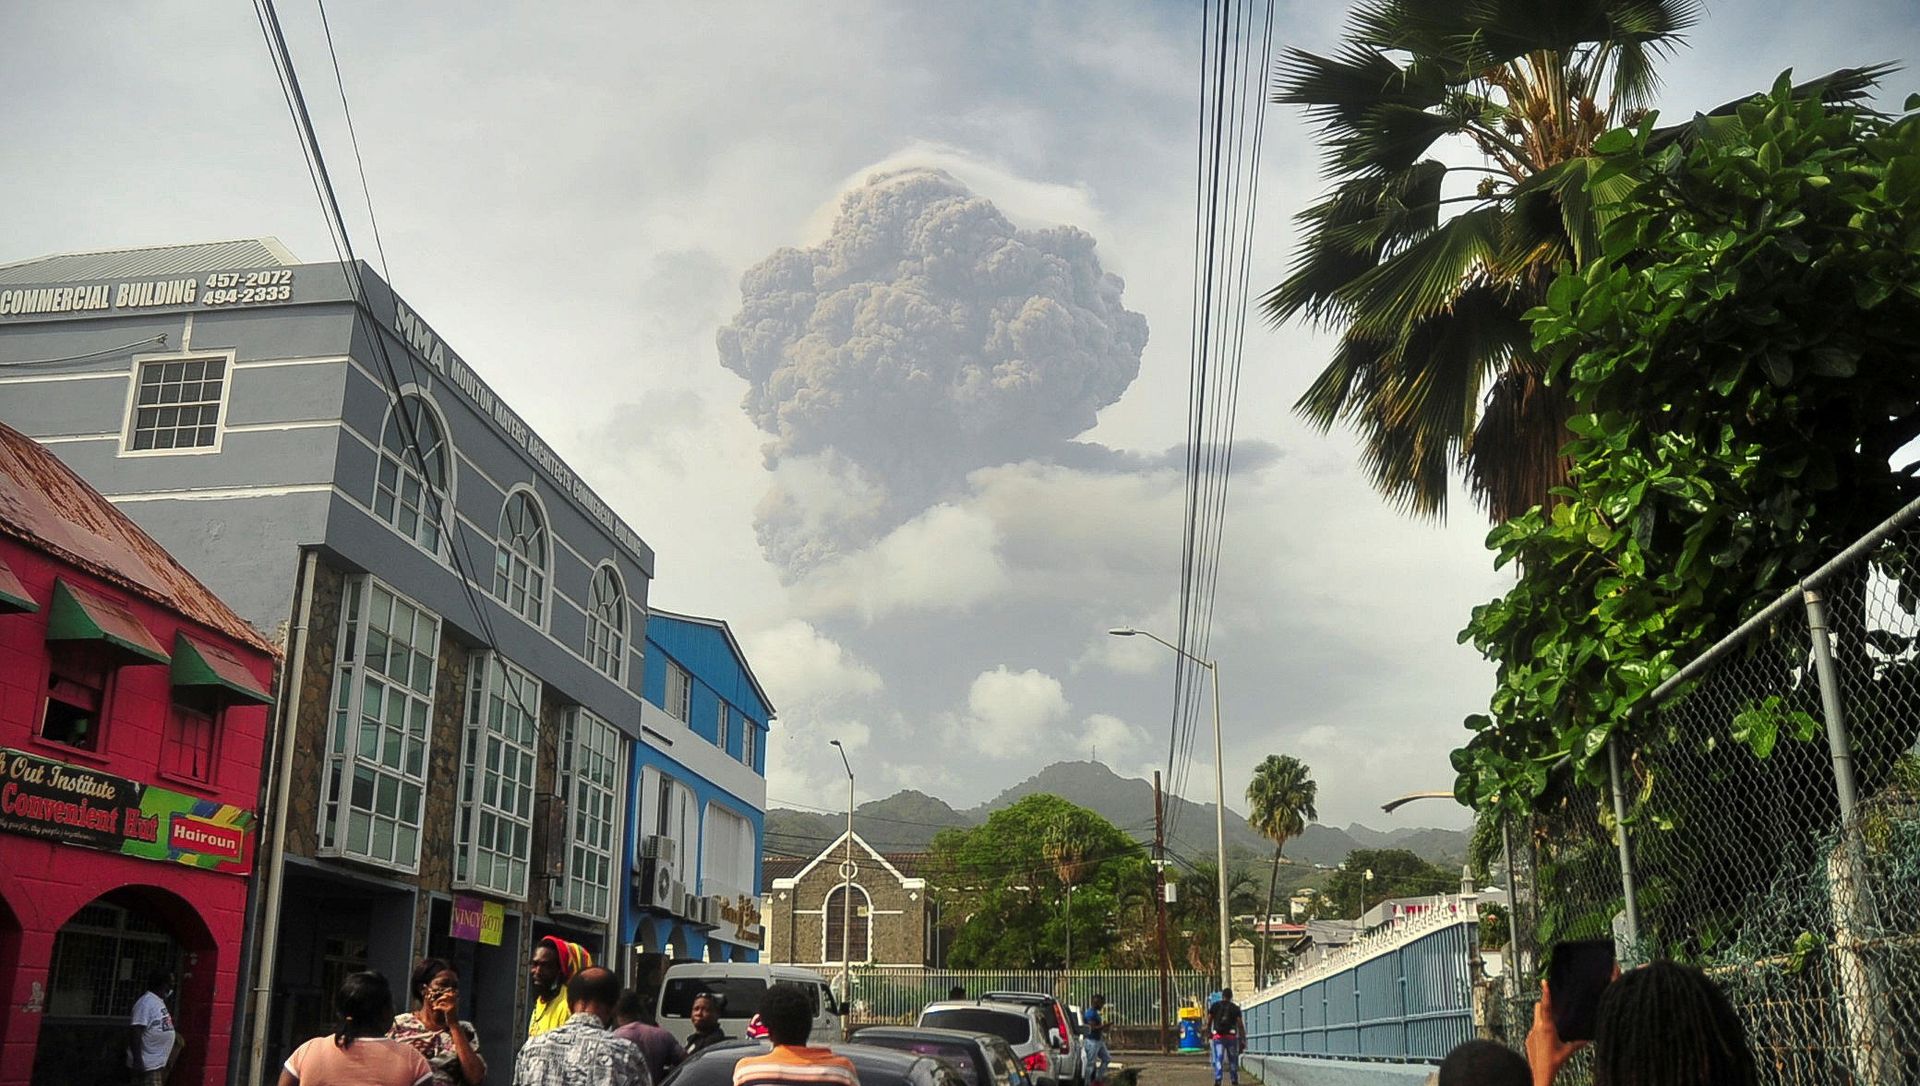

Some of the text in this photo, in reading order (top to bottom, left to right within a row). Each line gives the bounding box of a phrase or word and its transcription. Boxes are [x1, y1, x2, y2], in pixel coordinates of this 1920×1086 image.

[205, 269, 292, 288] 457-2072
[0, 278, 197, 315] COMMERCIAL BUILDING
[202, 286, 291, 306] 494-2333
[394, 301, 641, 559] MMA MOULTON MAYERS ARCHITECTS COMMERCIAL BUILDING
[10, 755, 45, 785] Out
[47, 764, 117, 800] Institute
[1, 781, 119, 834] Convenient
[122, 807, 159, 842] Hut
[173, 824, 236, 850] Hairoun
[454, 907, 483, 929] VINCY
